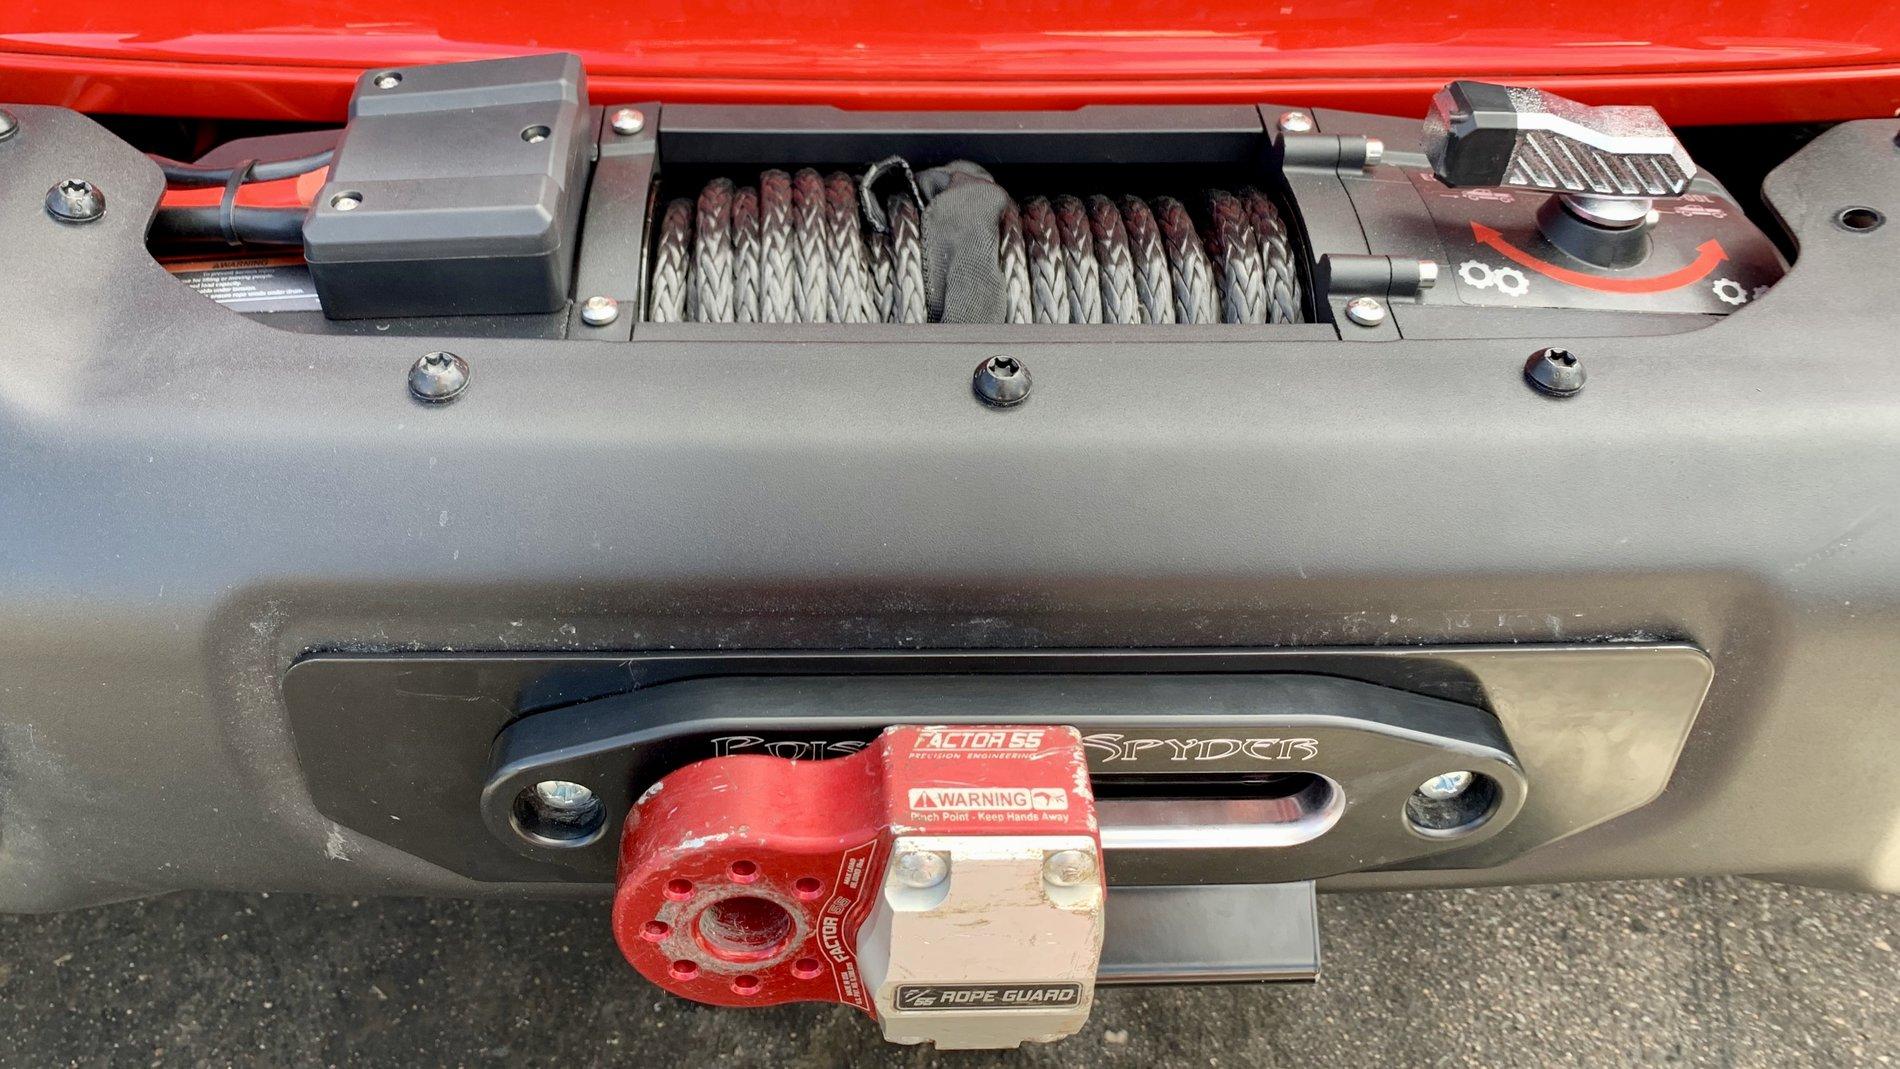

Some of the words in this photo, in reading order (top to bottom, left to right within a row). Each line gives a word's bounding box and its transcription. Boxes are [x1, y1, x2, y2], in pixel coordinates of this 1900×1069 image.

[913, 732, 1006, 749] FACTOR
[1008, 732, 1045, 749] 55
[908, 752, 962, 760] PRECISION
[966, 752, 1037, 761] ENGINEERING
[937, 791, 1027, 808] WARNING
[943, 812, 969, 822] Point
[978, 812, 1004, 823] Keep
[1006, 812, 1039, 822] Hands
[1042, 812, 1069, 823] Away
[822, 916, 850, 963] FACTOR
[940, 991, 999, 1004] ROPE
[1002, 989, 1075, 1002] GUARD
